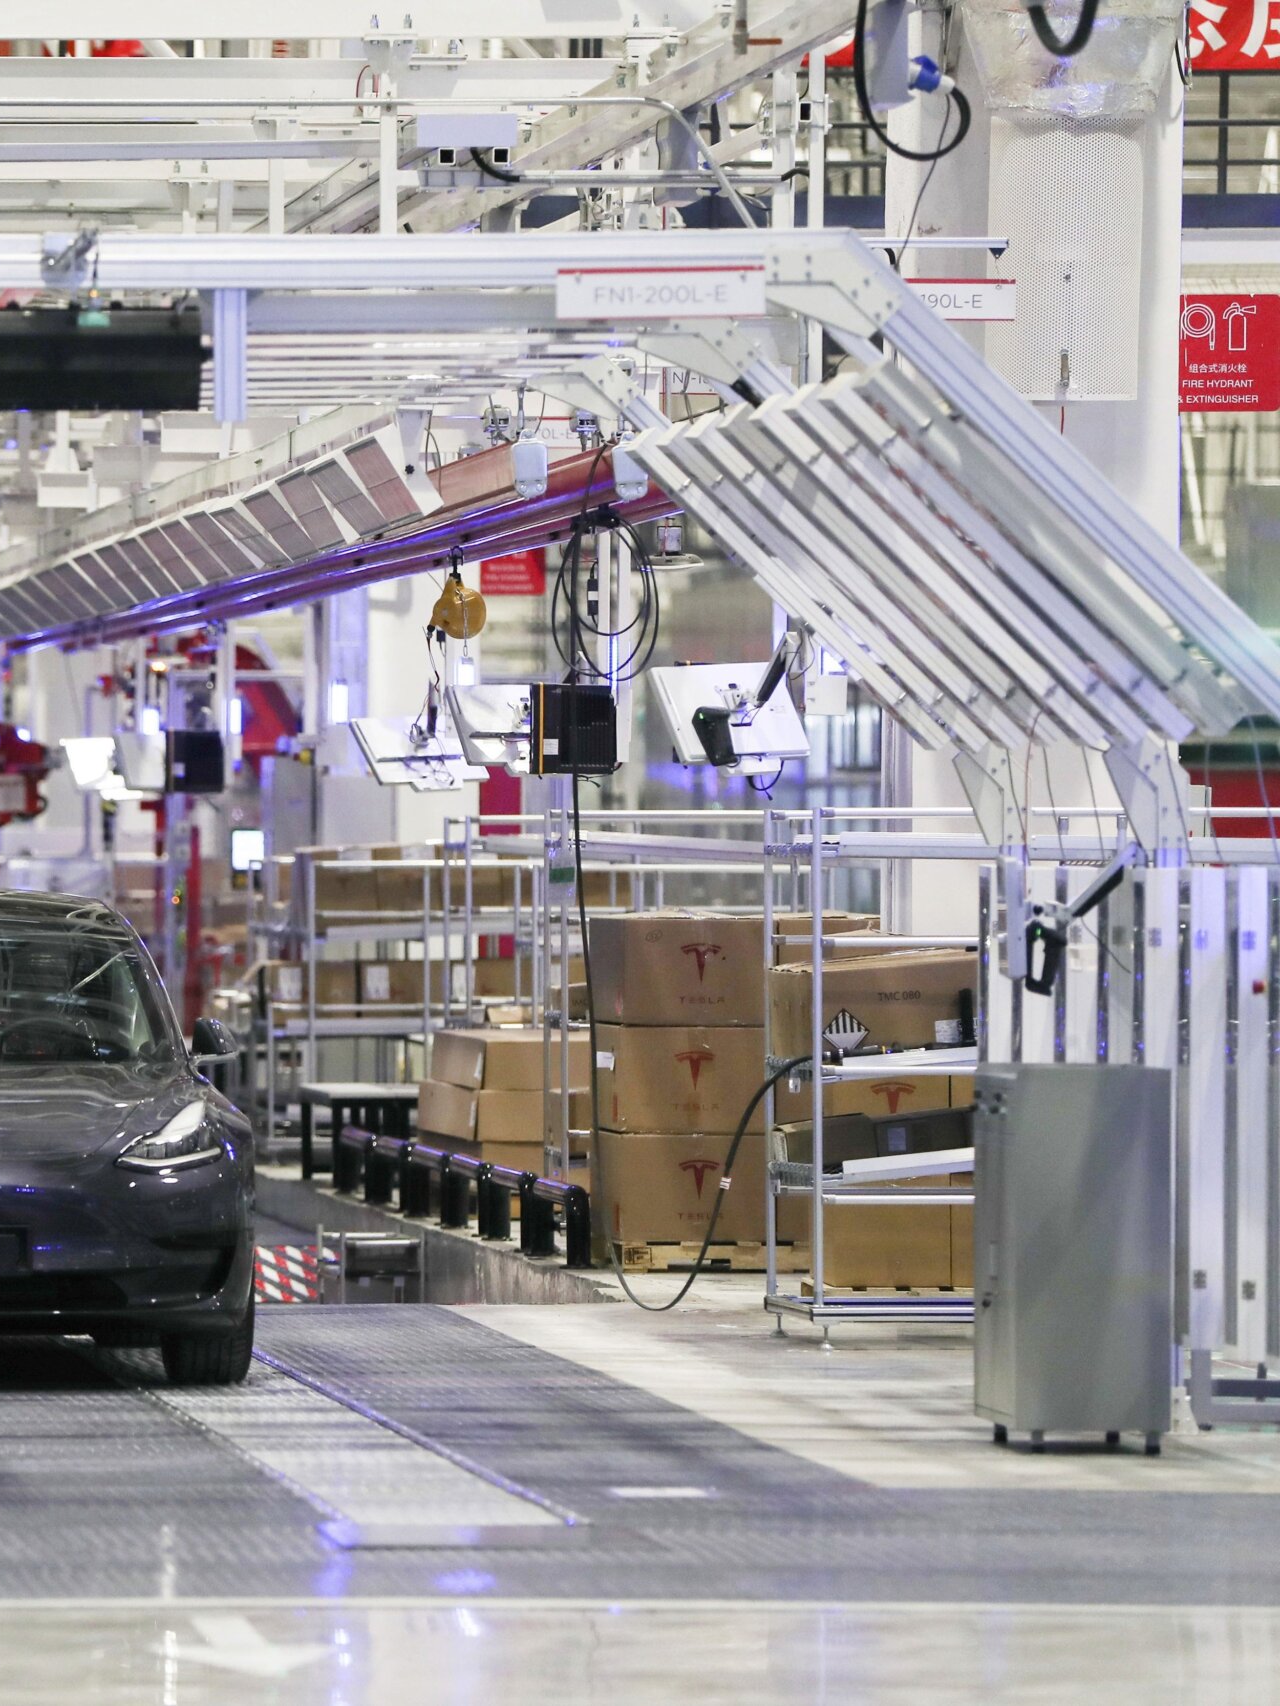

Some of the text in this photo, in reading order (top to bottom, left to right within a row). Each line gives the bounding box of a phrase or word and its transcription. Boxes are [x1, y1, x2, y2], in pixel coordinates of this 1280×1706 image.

[594, 284, 728, 304] FN1-200L-E
[1189, 363, 1247, 373] 组合式消火栓
[1182, 380, 1253, 388] FIRE HYDRANT
[1186, 395, 1259, 403] EXTINGUISHER
[902, 989, 921, 1000] 080
